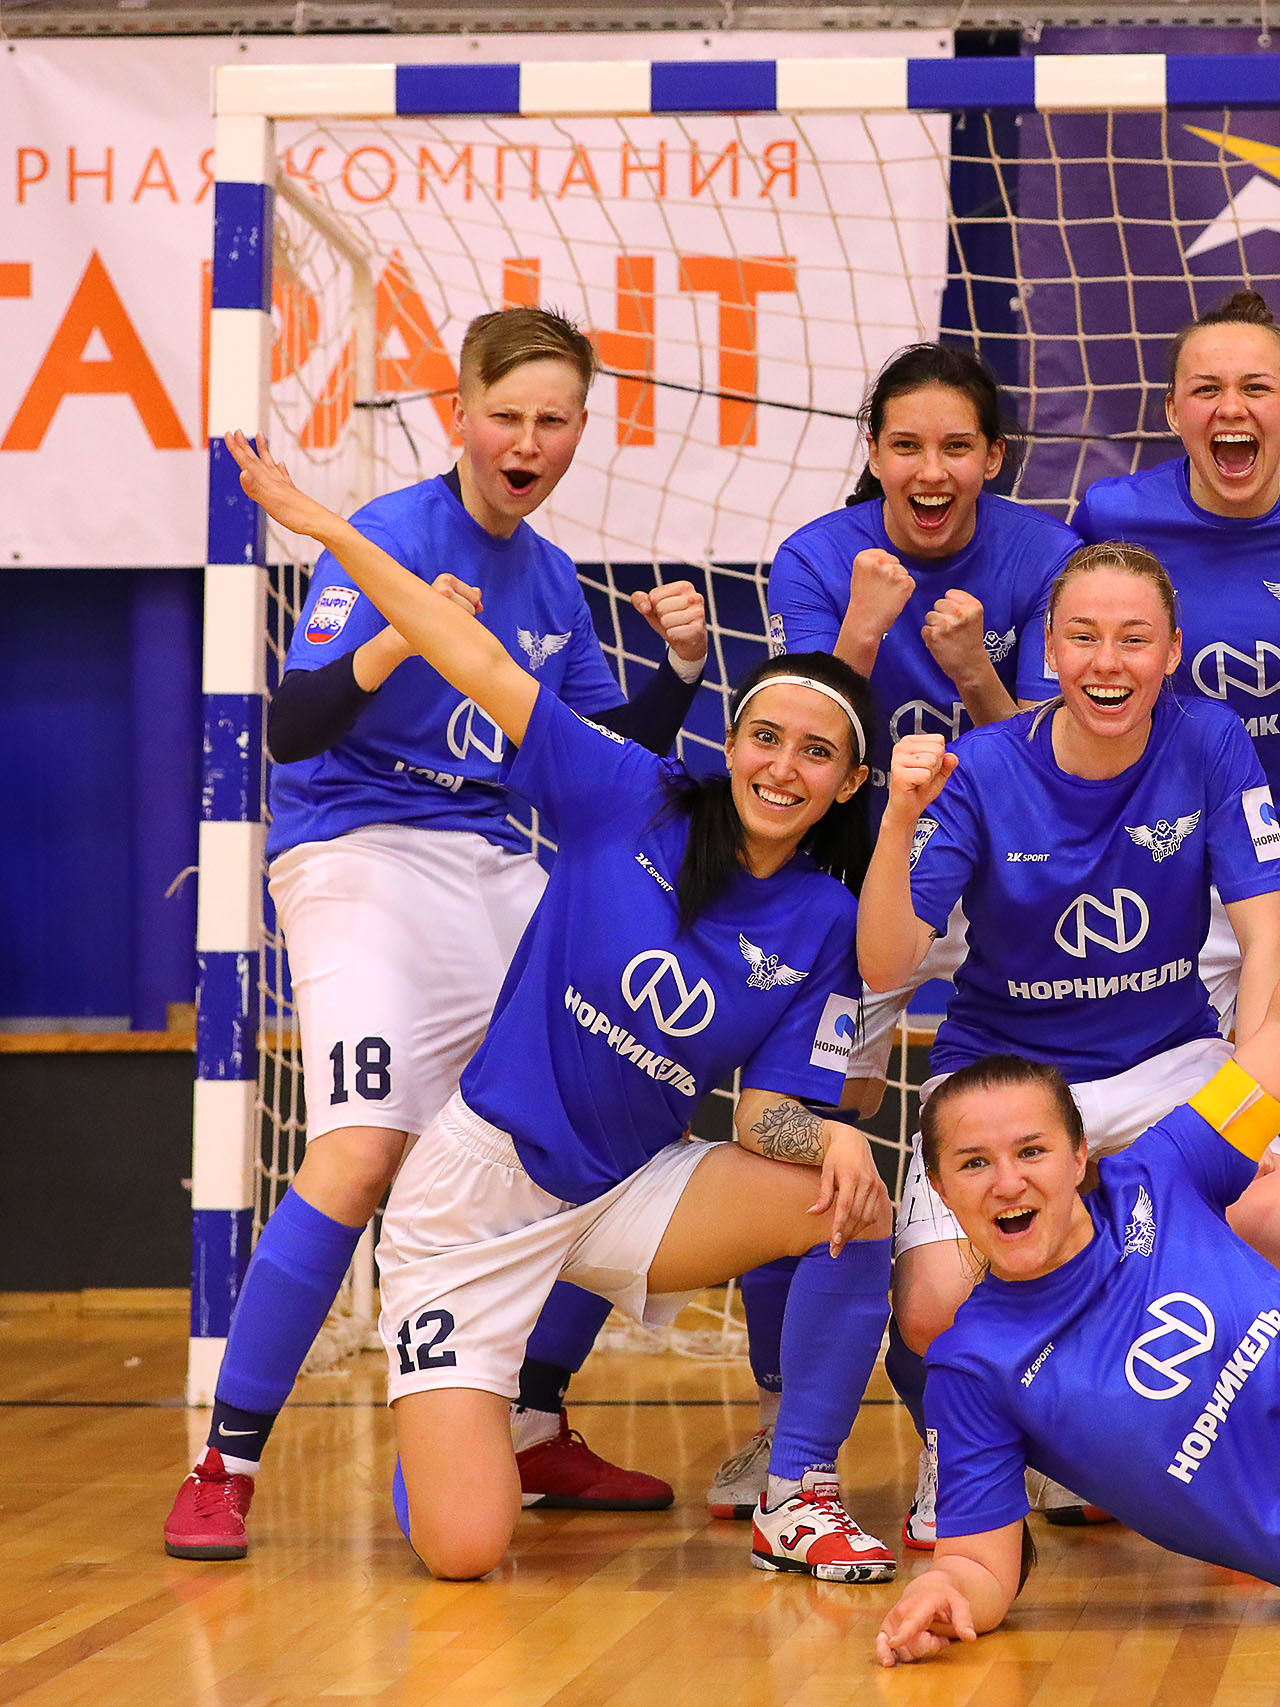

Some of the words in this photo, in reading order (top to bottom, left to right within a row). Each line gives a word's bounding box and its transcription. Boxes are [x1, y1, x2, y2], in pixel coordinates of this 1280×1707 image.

[0, 247, 799, 450] АРАНТ
[646, 865, 674, 892] SPORT
[1022, 853, 1051, 862] SPORT
[1007, 957, 1193, 1000] НОРНИКЕЛЬ
[564, 984, 697, 1097] НОРНИКЕЛЬ
[329, 1036, 391, 1105] 18
[397, 1309, 457, 1375] 12
[1031, 1341, 1056, 1374] SPORT
